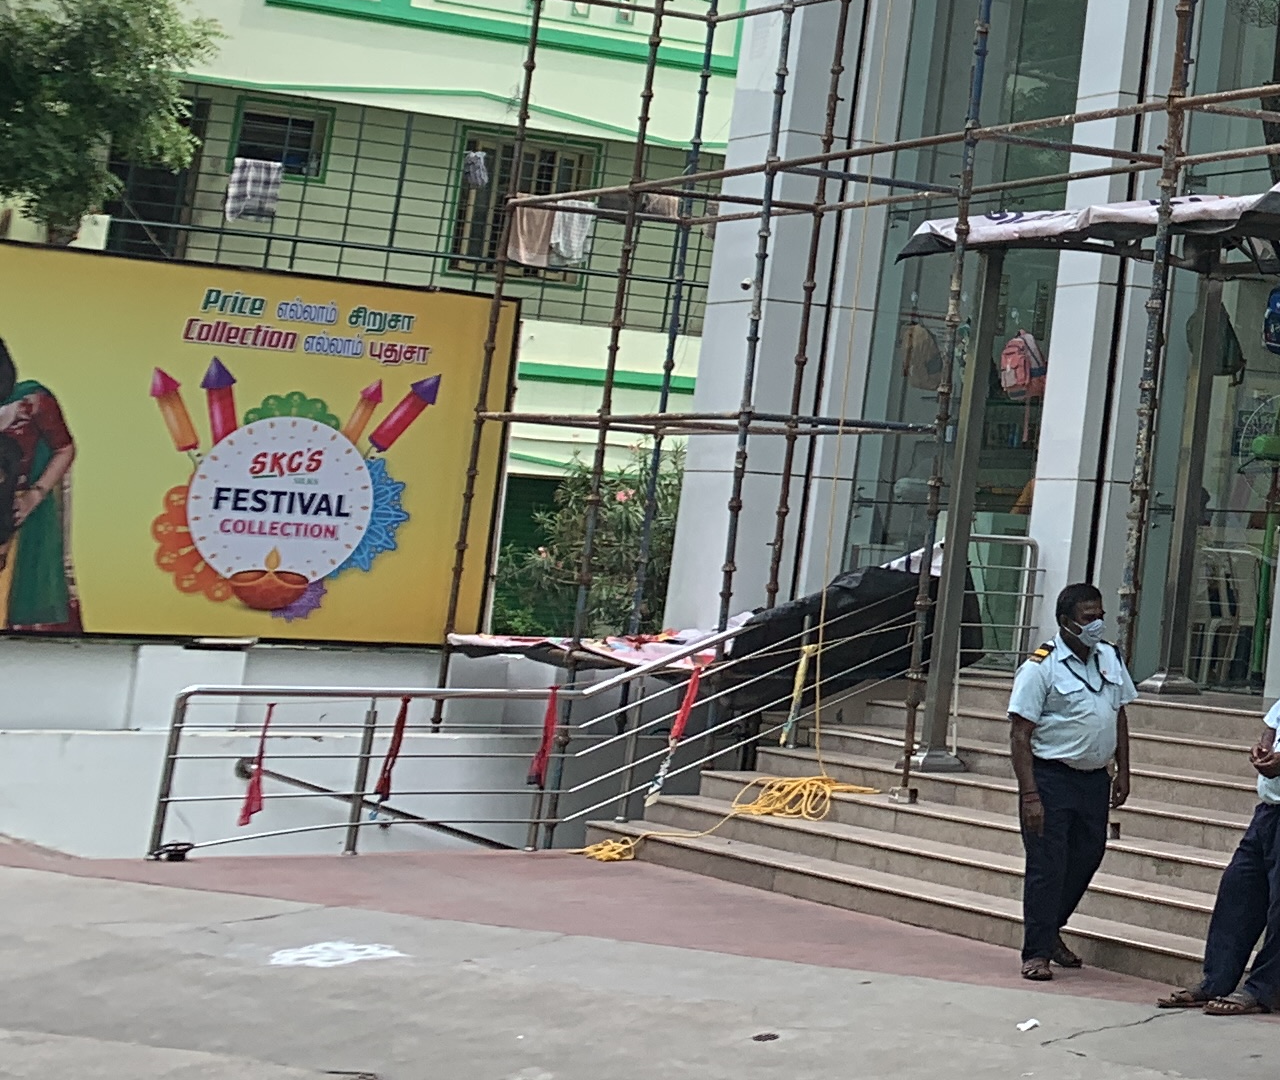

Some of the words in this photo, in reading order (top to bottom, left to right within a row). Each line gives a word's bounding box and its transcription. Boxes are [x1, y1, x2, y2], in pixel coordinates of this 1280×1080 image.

[201, 287, 266, 316] Price
[276, 297, 339, 324] எல்லாம்
[348, 306, 416, 334] சிறுசா
[182, 318, 298, 350] Collection
[303, 331, 365, 357] எல்லாம்
[369, 340, 431, 364] புதுசா
[248, 447, 325, 477] SKC'S
[212, 486, 351, 518] FESTIVAL
[219, 518, 338, 539] COLLECTION
